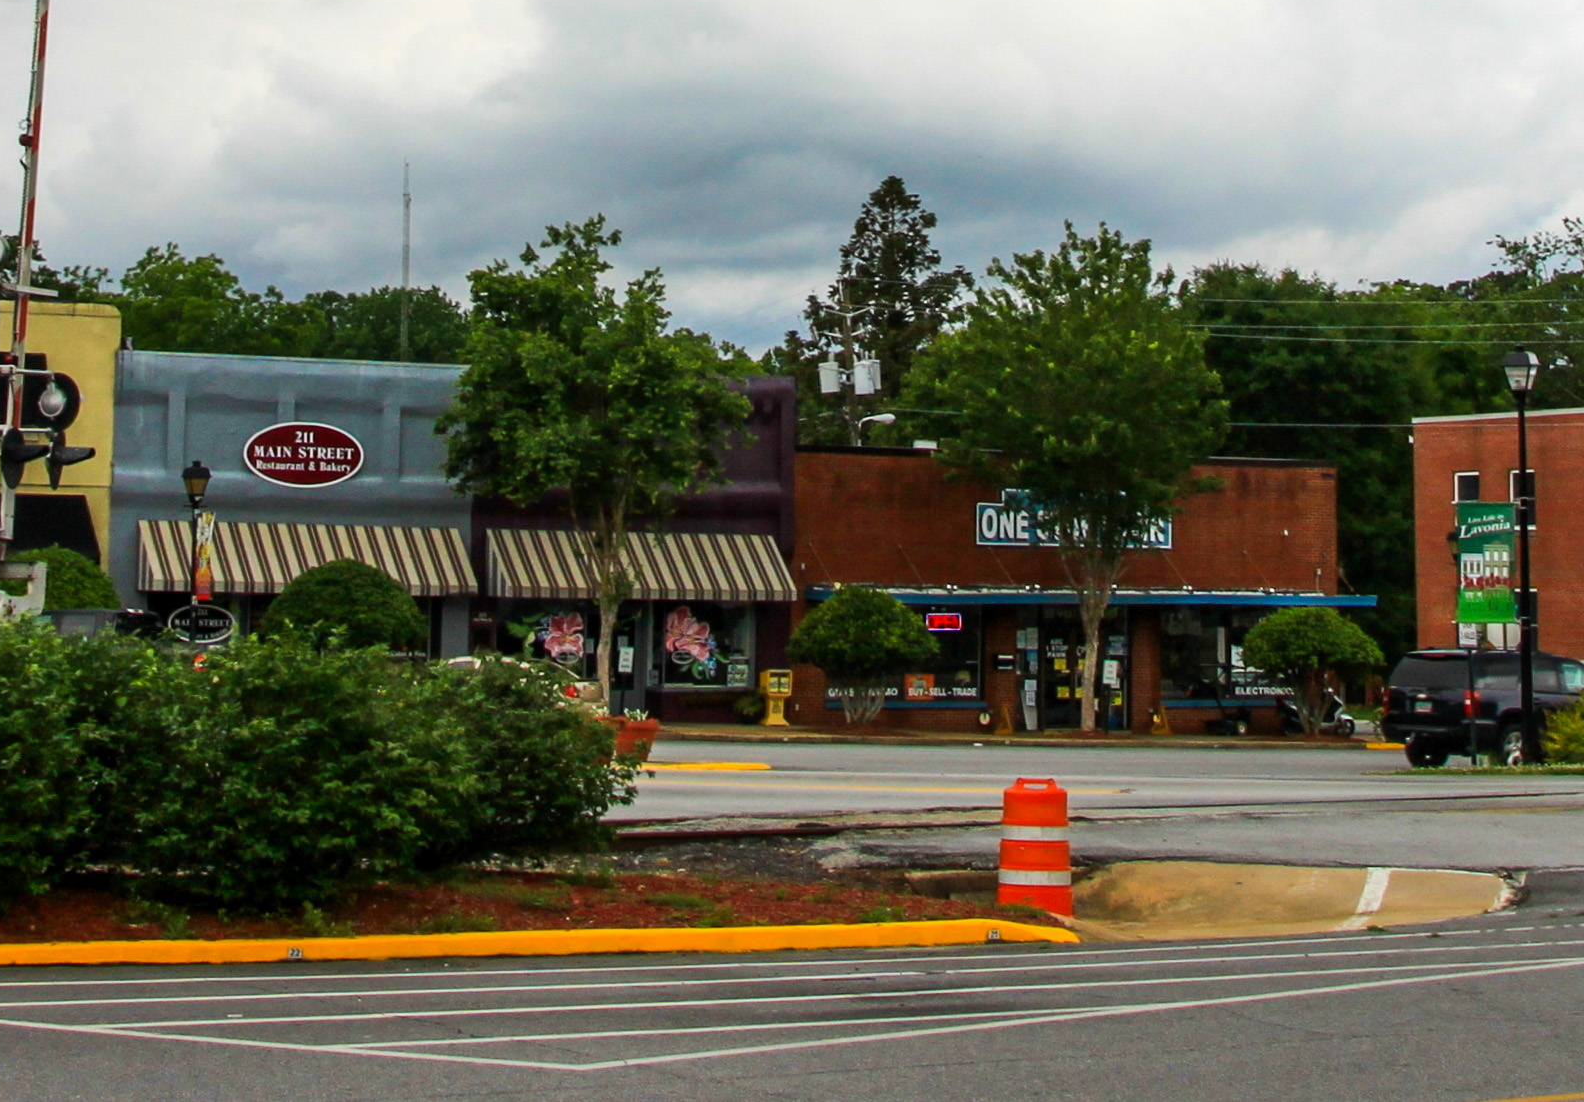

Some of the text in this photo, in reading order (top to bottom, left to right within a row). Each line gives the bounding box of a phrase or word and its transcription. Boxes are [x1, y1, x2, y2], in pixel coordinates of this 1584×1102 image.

[294, 430, 314, 443] 211
[254, 445, 355, 460] MAIN STREET
[256, 460, 351, 474] Restaurant & Bakery
[981, 508, 1030, 540] ONE
[1459, 519, 1511, 539] Lavonia
[199, 619, 231, 627] STREET
